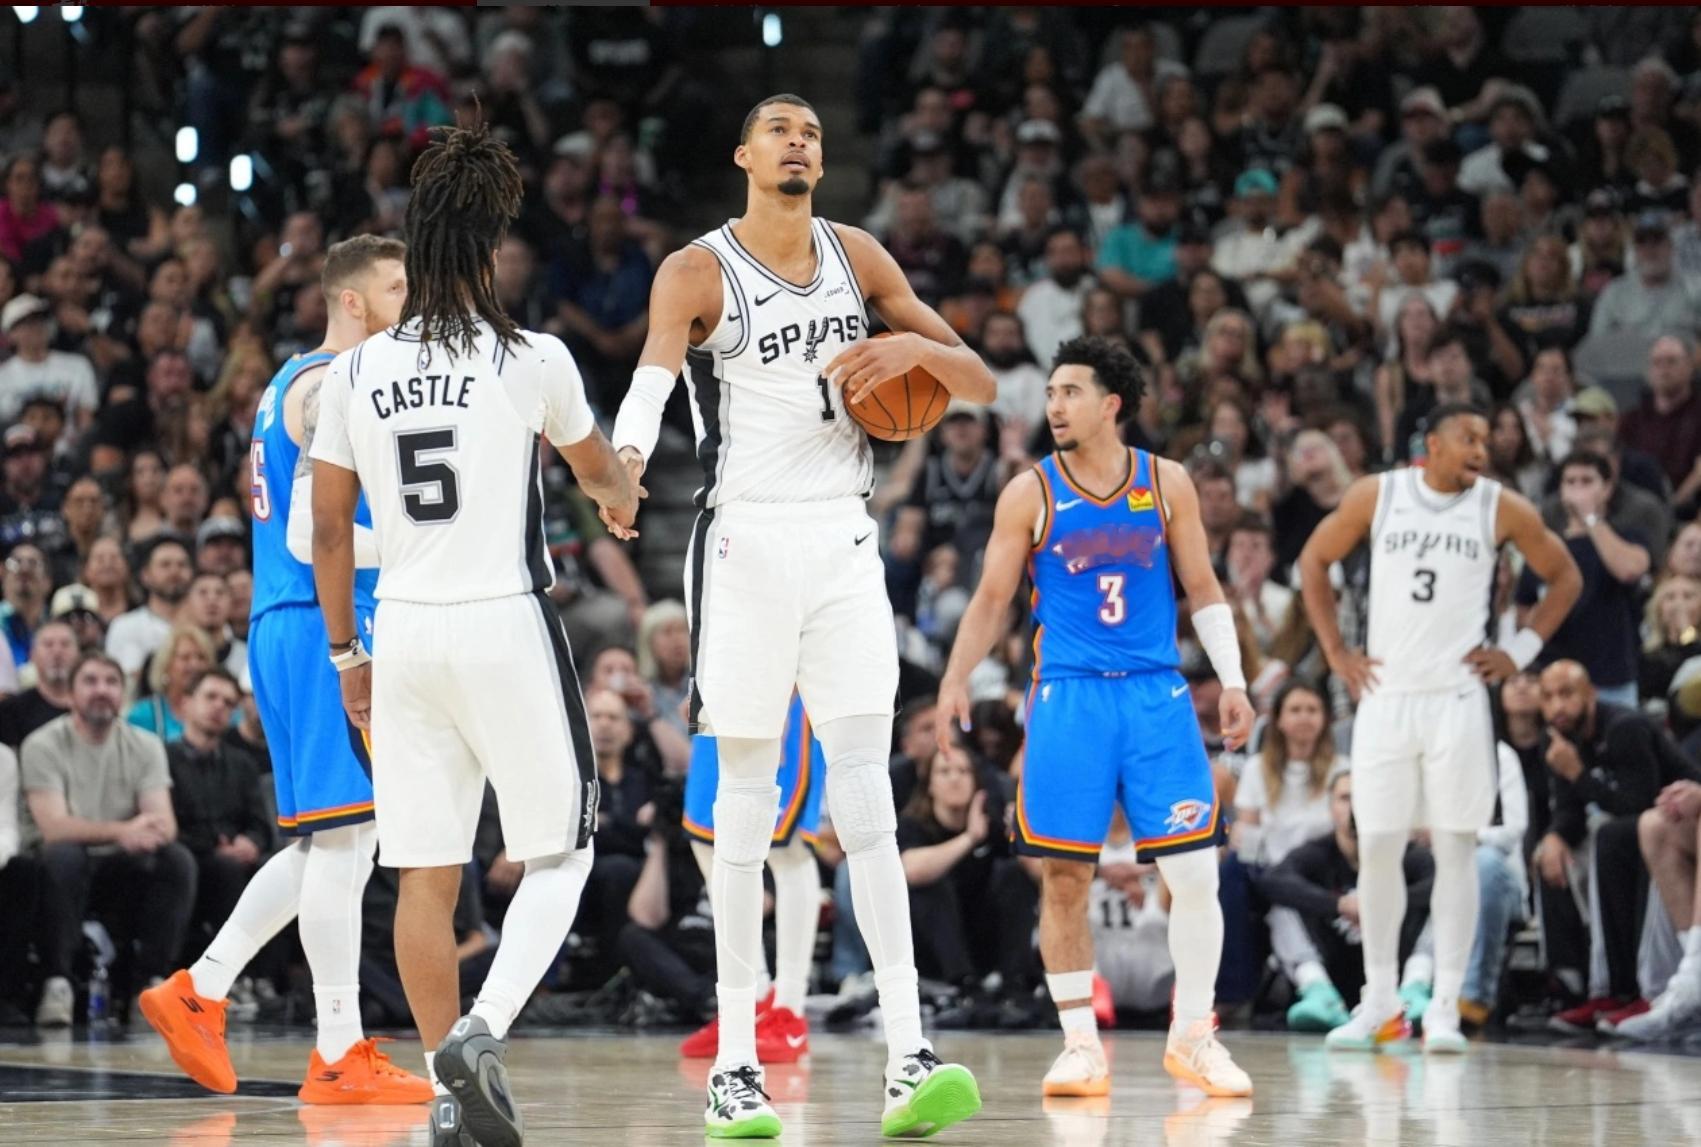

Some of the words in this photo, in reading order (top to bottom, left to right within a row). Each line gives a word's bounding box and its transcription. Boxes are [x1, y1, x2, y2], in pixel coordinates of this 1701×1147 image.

[758, 315, 859, 364] SPURS
[371, 374, 475, 419] CASTLE
[817, 373, 835, 421] 1
[250, 439, 271, 522] 5
[392, 424, 462, 526] 5
[1385, 530, 1479, 560] SPURS
[1098, 573, 1126, 625] 3
[1412, 568, 1436, 602] 3
[1101, 899, 1132, 929] 11
